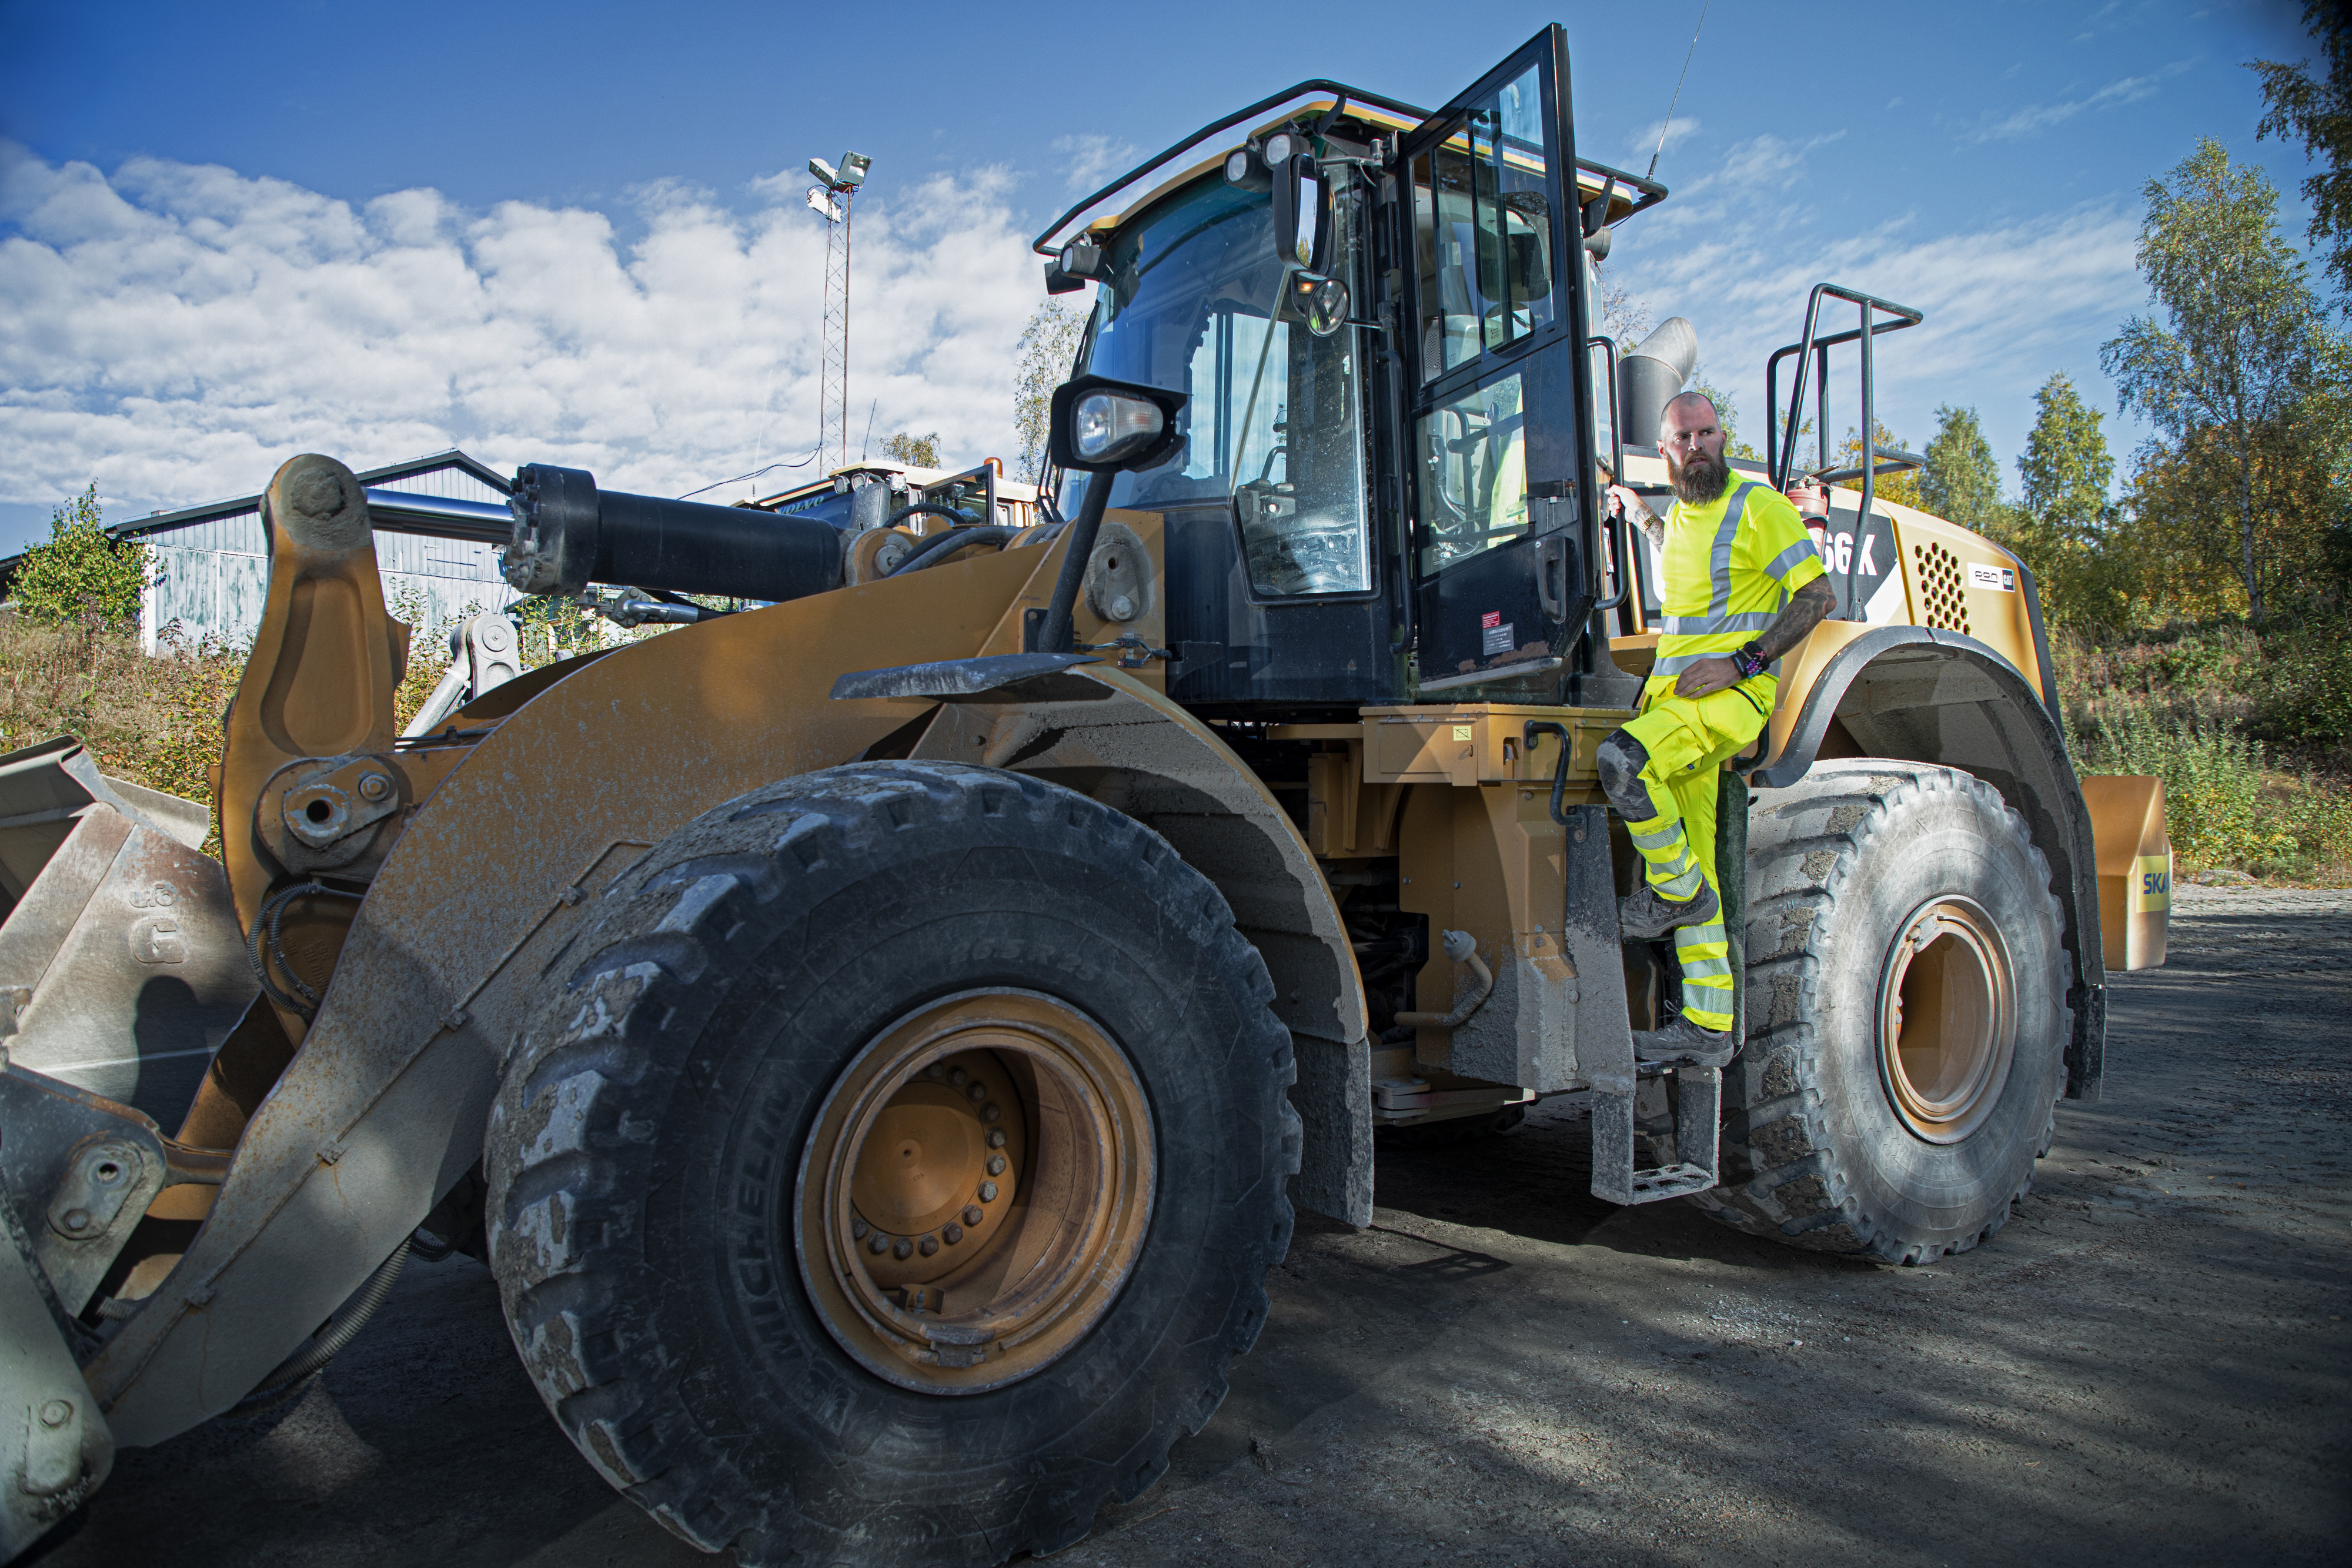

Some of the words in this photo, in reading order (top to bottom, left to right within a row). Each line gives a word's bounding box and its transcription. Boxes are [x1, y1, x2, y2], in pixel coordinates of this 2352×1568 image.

[777, 495, 824, 514] VOLVO
[1975, 570, 1998, 580] pon
[2003, 574, 2013, 586] CAT
[949, 938, 1025, 965] 26.5
[1028, 942, 1057, 964] R
[1056, 953, 1102, 981] 25
[736, 1088, 804, 1363] MICHELIN
